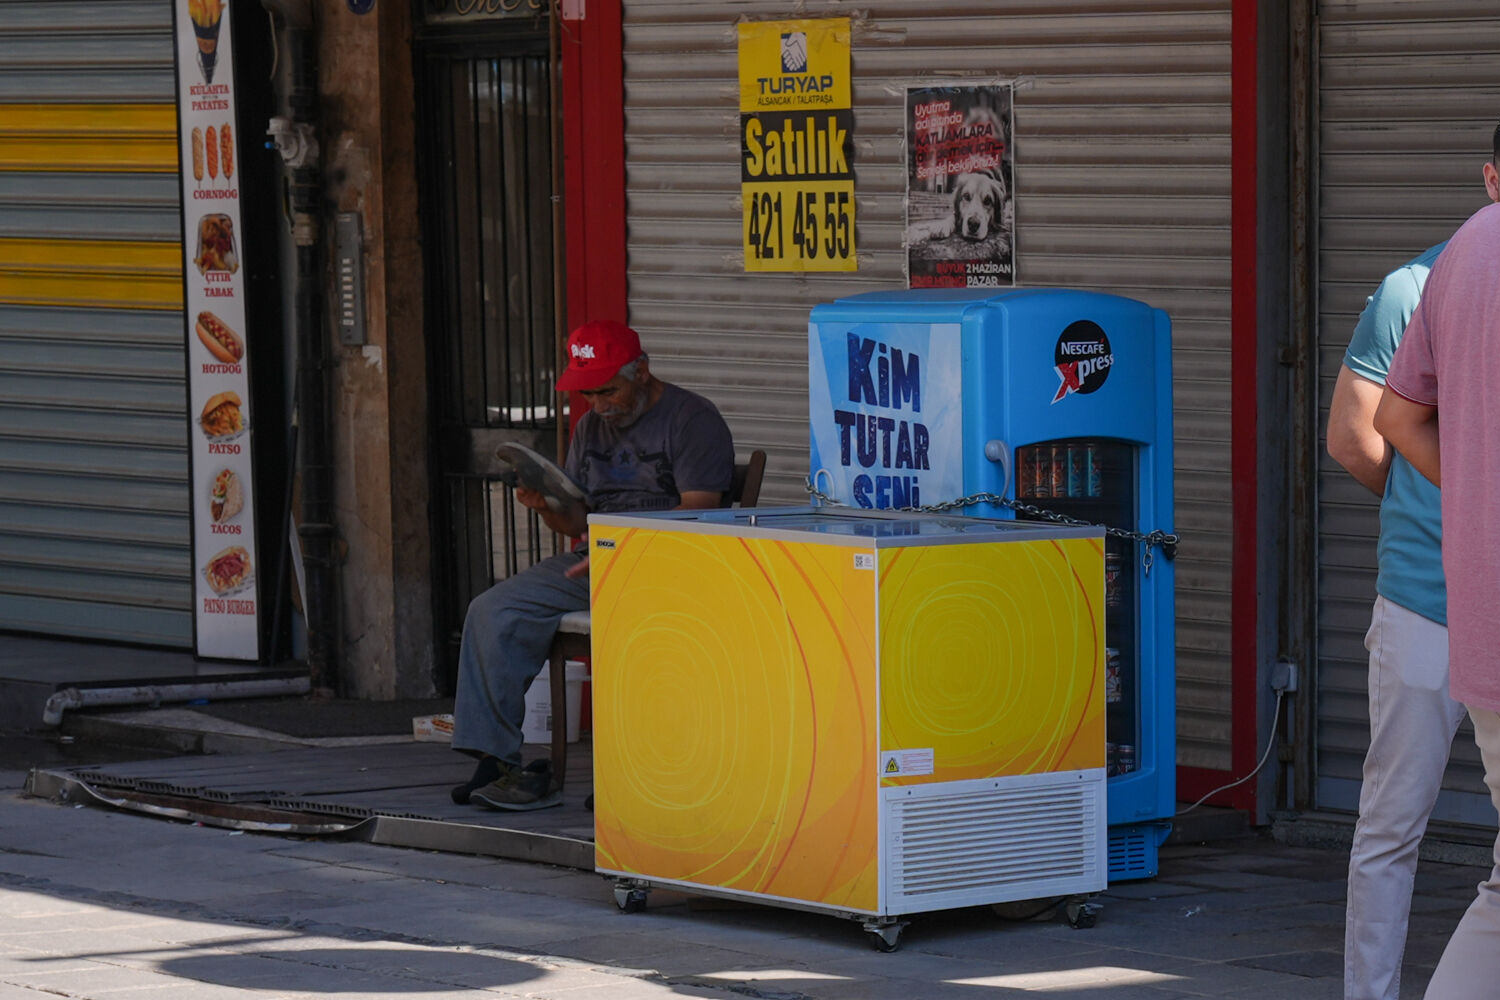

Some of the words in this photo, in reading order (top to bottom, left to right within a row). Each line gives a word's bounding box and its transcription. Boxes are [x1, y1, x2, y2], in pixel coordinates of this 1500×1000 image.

[190, 83, 230, 95] KÜLAHTA
[757, 75, 833, 95] TURYAP
[192, 100, 229, 111] PATATES
[757, 96, 792, 106] ALSANCAK
[797, 94, 833, 105] TALATPAŞA
[915, 101, 950, 117] Uyutma
[745, 116, 848, 177] Satılık
[193, 189, 238, 200] CORNDOG
[749, 191, 784, 260] 421
[793, 190, 818, 260] 45
[824, 191, 849, 260] 55
[966, 263, 972, 274] 2
[972, 260, 1011, 274] HAZİRAN
[205, 272, 231, 284] ÇITIR
[966, 275, 999, 287] PAZAR
[204, 287, 234, 298] TABAK
[1061, 337, 1105, 355] NESCAFÉ
[202, 364, 242, 375] HOTDOG
[834, 409, 930, 471] TUTAR
[208, 443, 241, 455] PATSO
[211, 524, 242, 535] TACOS
[203, 598, 225, 614] PATSO
[226, 598, 256, 616] BURGER
